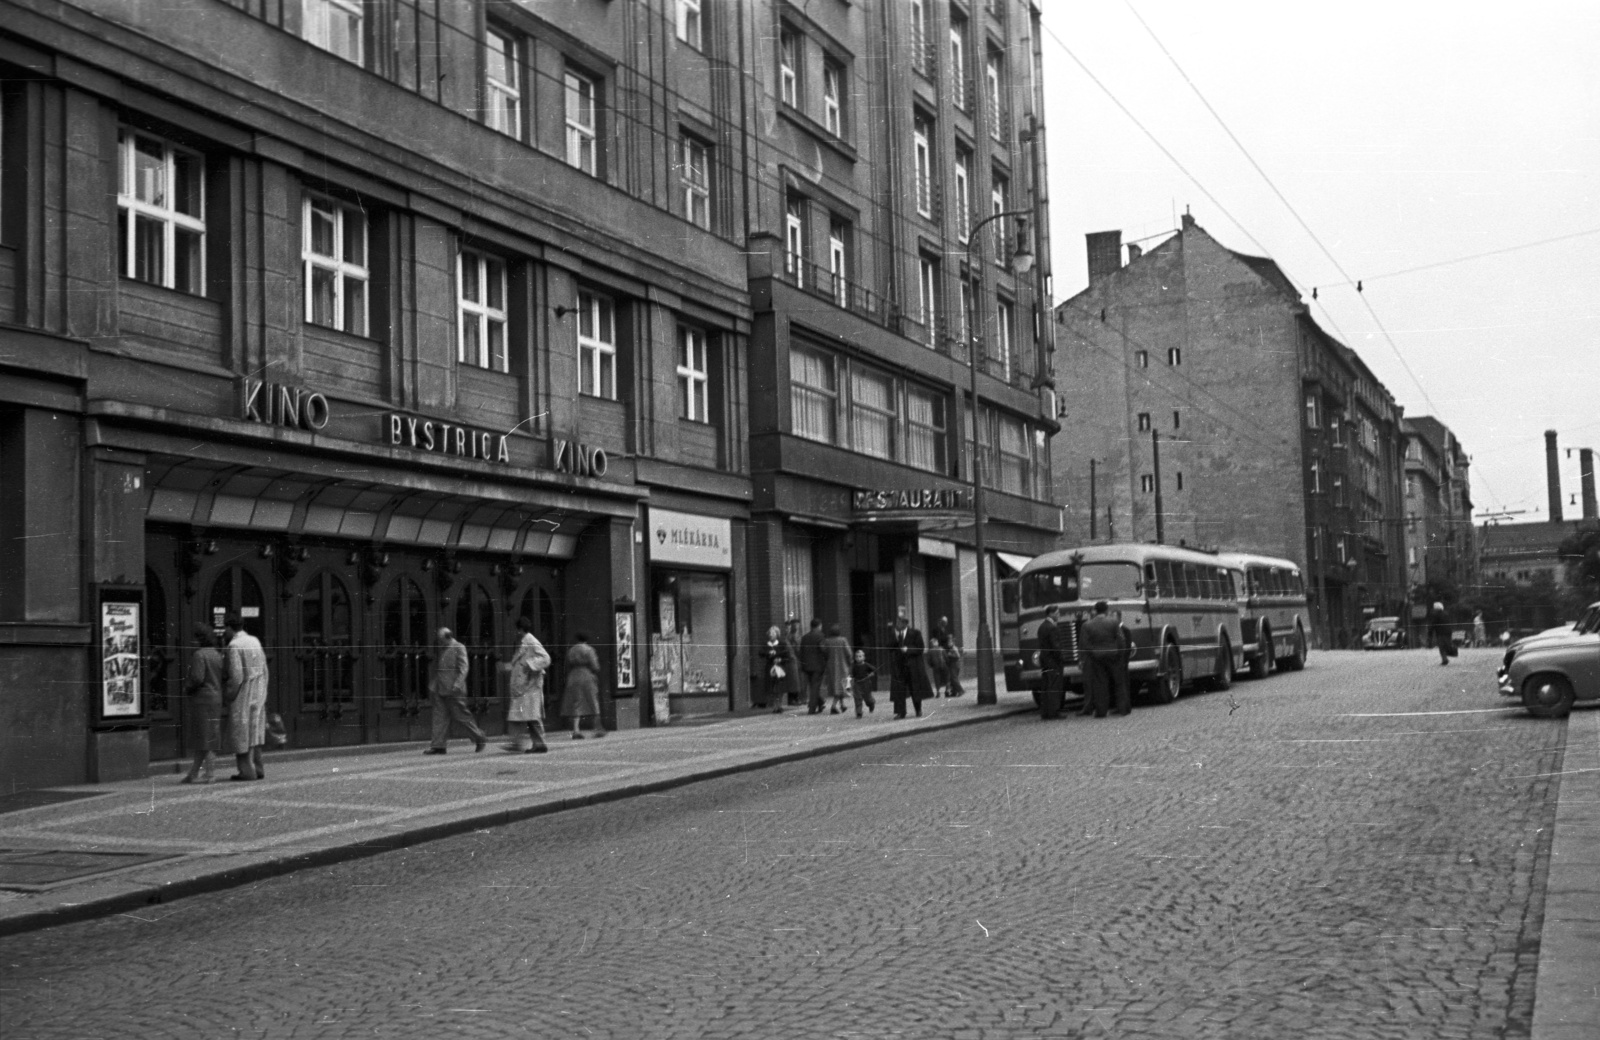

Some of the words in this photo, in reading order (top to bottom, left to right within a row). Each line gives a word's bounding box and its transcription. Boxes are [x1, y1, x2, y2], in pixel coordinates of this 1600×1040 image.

[242, 378, 329, 430] KINO
[391, 413, 509, 463] BYSTRICA
[553, 438, 608, 477] KINO
